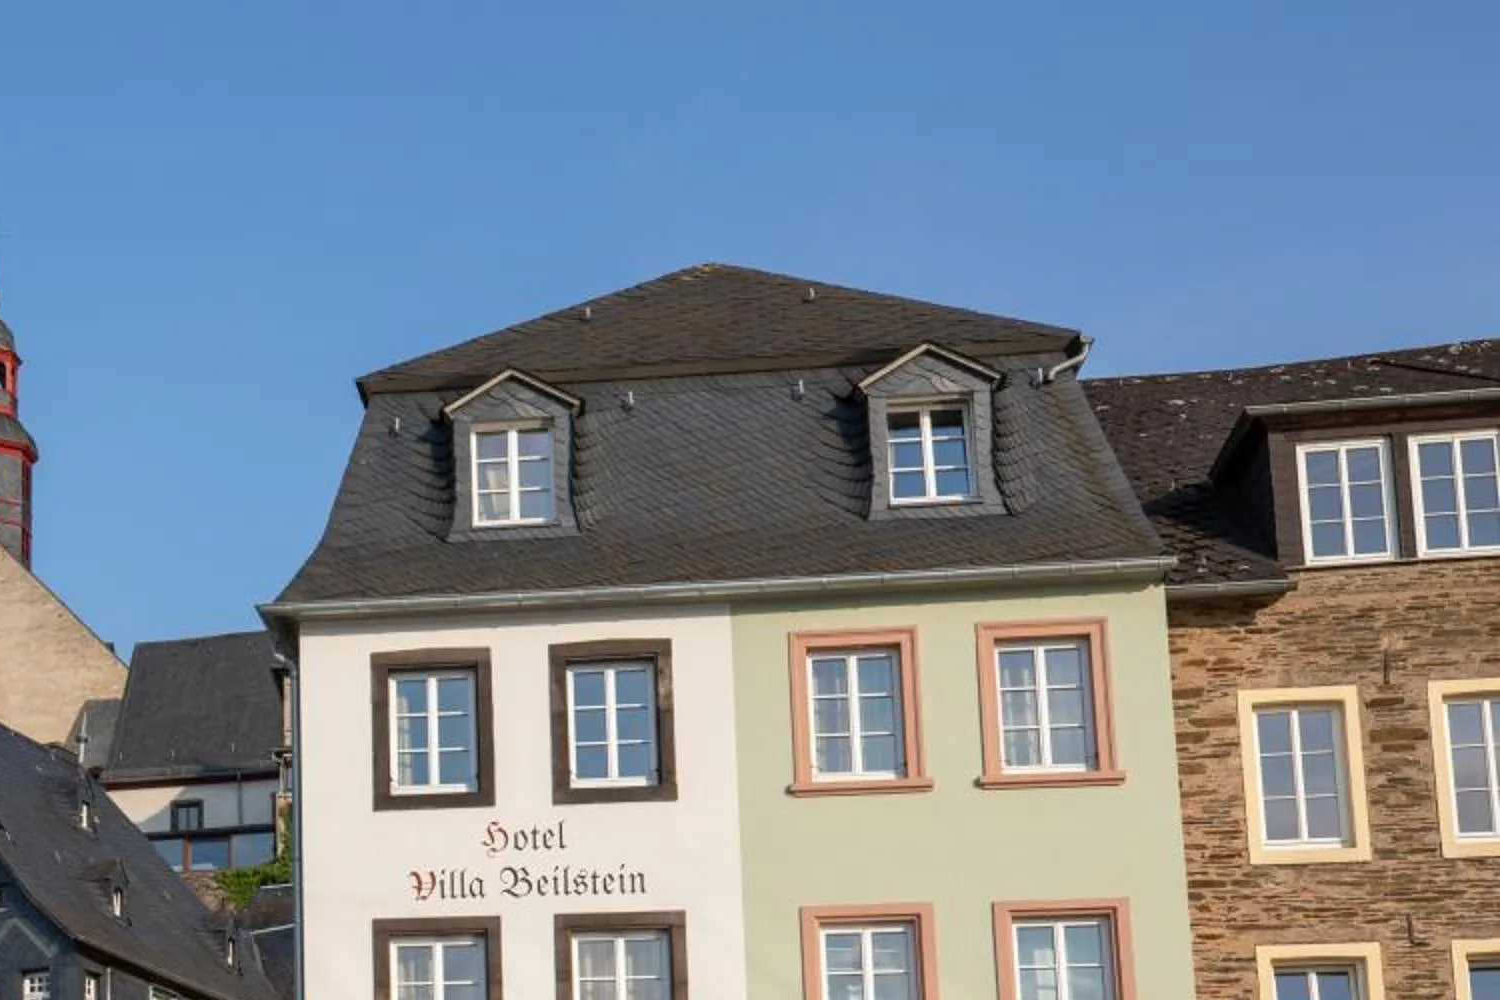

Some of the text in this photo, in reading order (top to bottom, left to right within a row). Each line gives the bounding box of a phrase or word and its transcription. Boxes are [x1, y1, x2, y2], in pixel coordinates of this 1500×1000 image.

[481, 819, 567, 858] Hotel
[408, 863, 647, 901] Villa Beilstein
